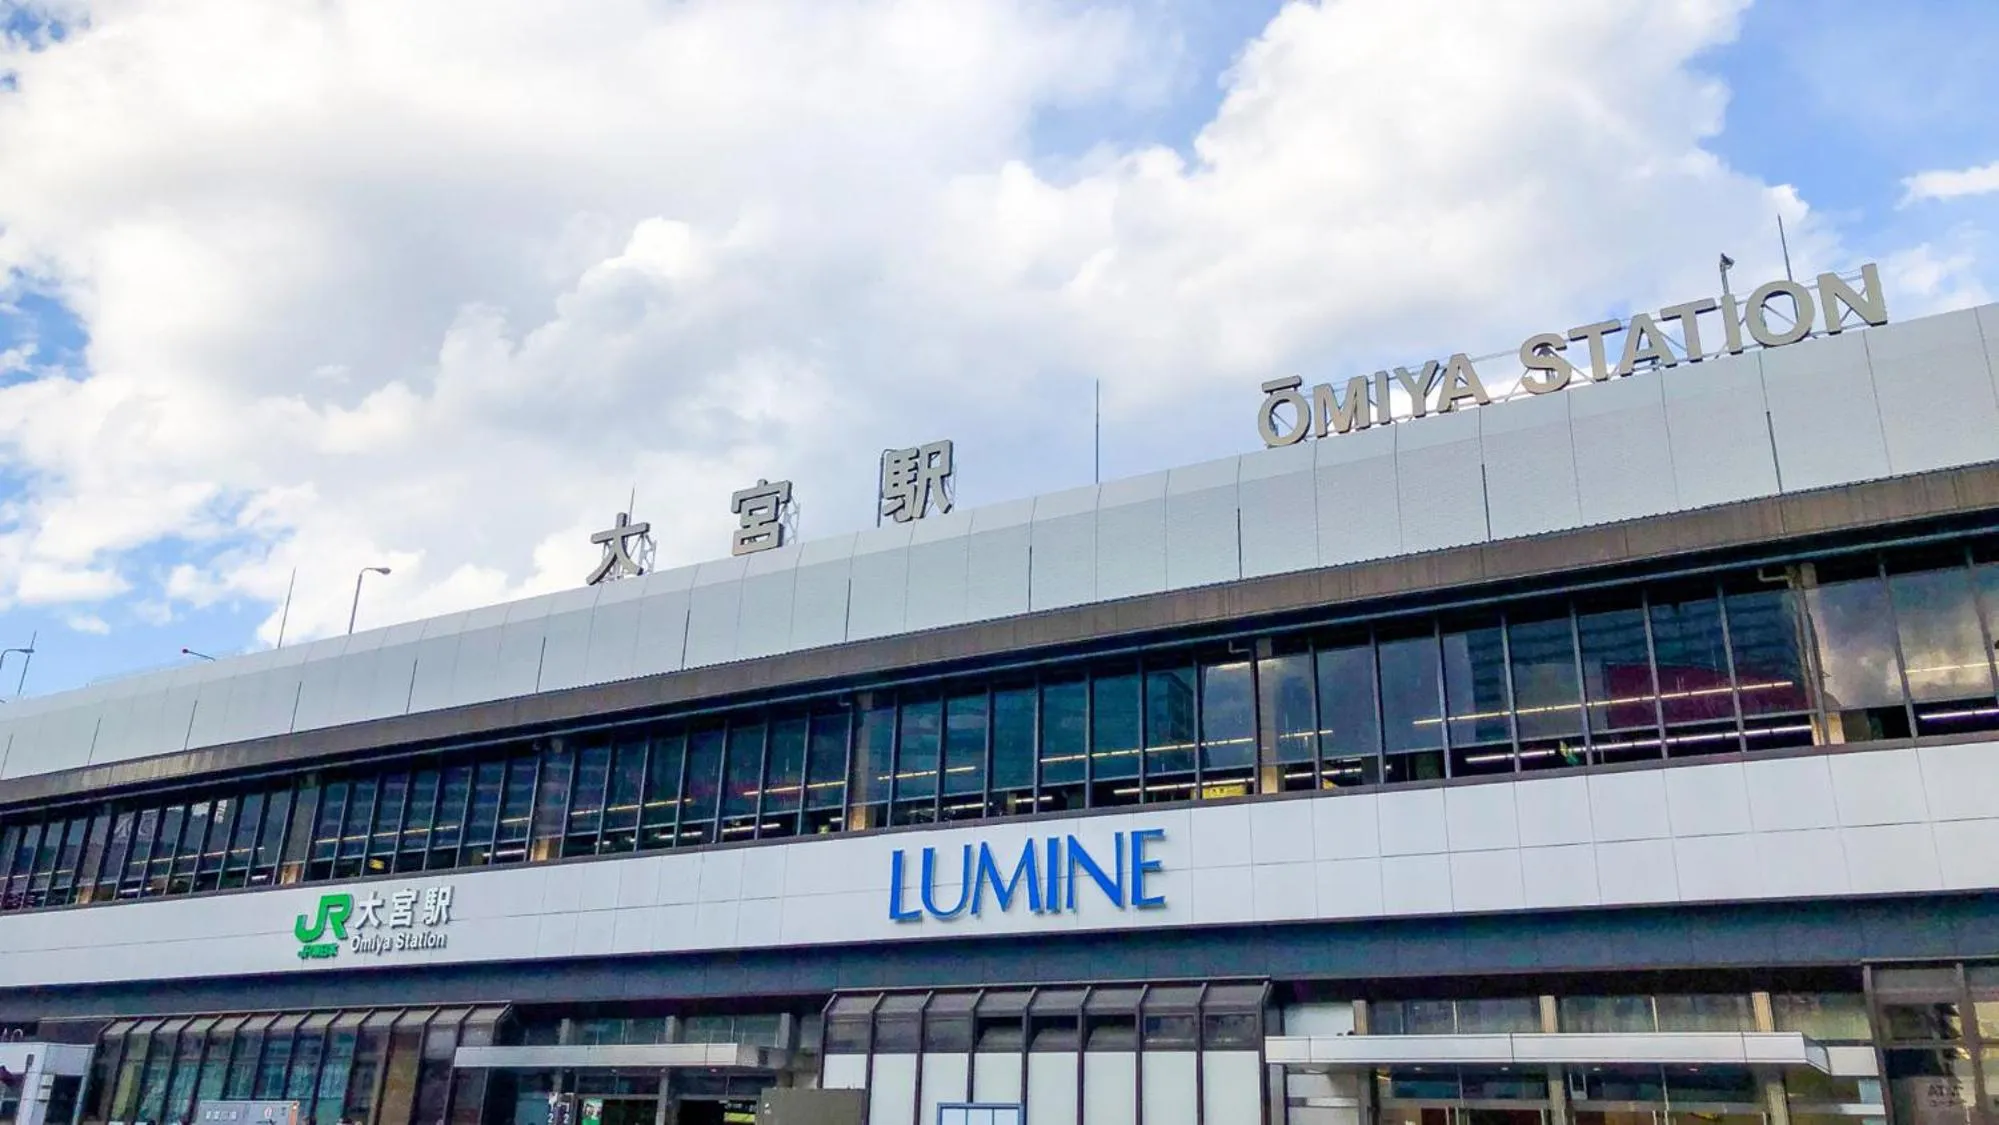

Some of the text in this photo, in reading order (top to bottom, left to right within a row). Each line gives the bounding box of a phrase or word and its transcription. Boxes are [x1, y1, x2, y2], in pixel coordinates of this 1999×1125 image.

[1519, 262, 1888, 395] STATION
[586, 439, 953, 585] 大宮駅
[355, 886, 455, 930] 大宮駅
[889, 828, 1167, 922] LUMINE
[294, 893, 353, 943] JR
[395, 930, 449, 951] Station
